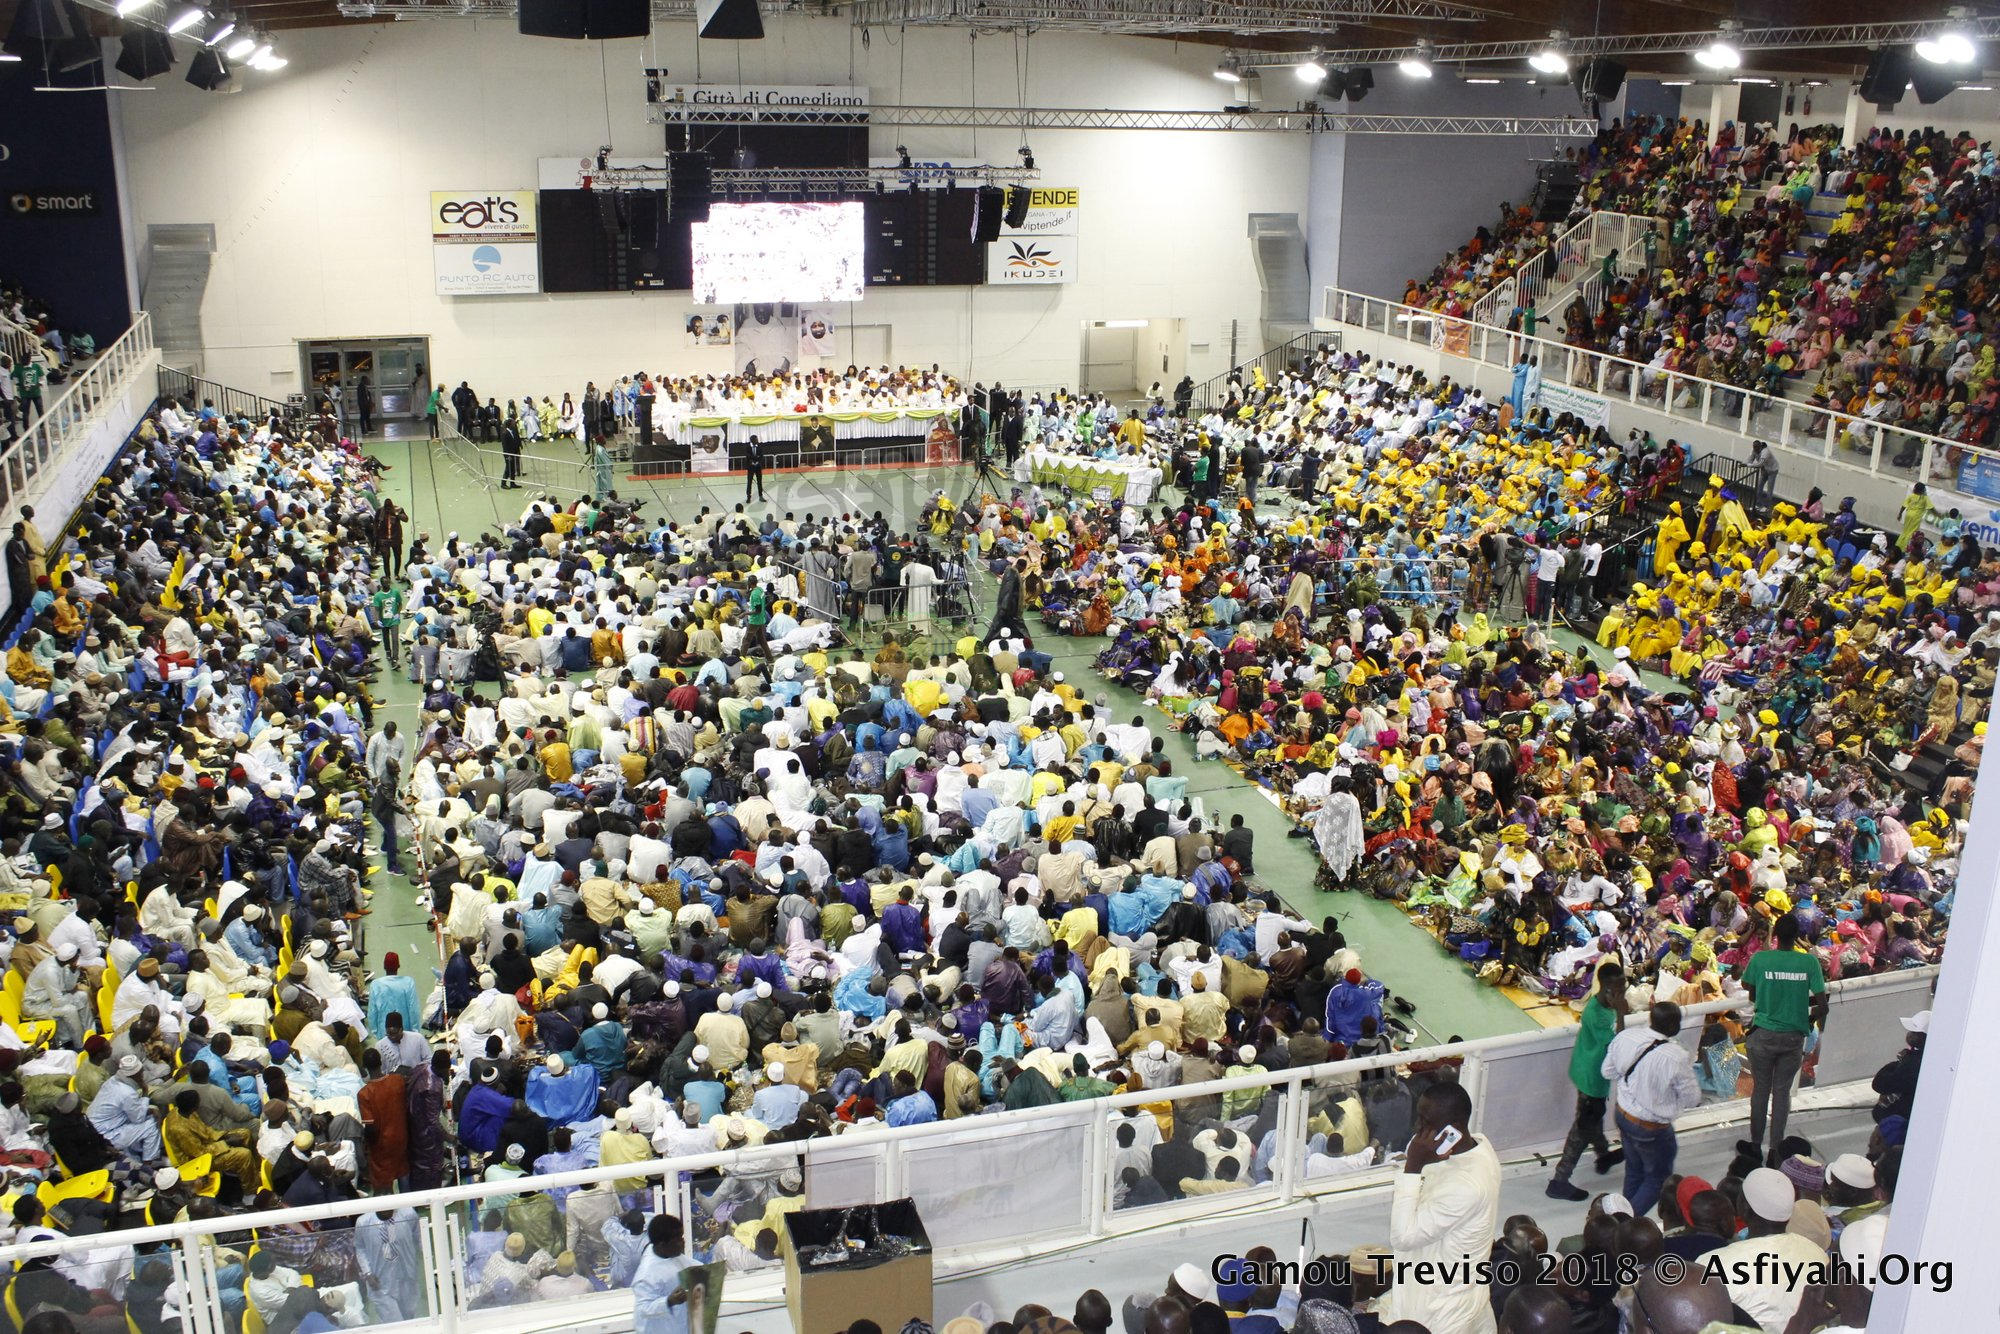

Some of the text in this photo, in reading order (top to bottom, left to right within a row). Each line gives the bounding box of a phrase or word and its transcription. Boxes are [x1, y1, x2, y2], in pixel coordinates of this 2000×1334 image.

[692, 90, 863, 111] Città di Conegliano
[36, 194, 93, 210] smart
[439, 196, 518, 229] eat's
[512, 223, 530, 231] gusto
[483, 273, 501, 281] RC
